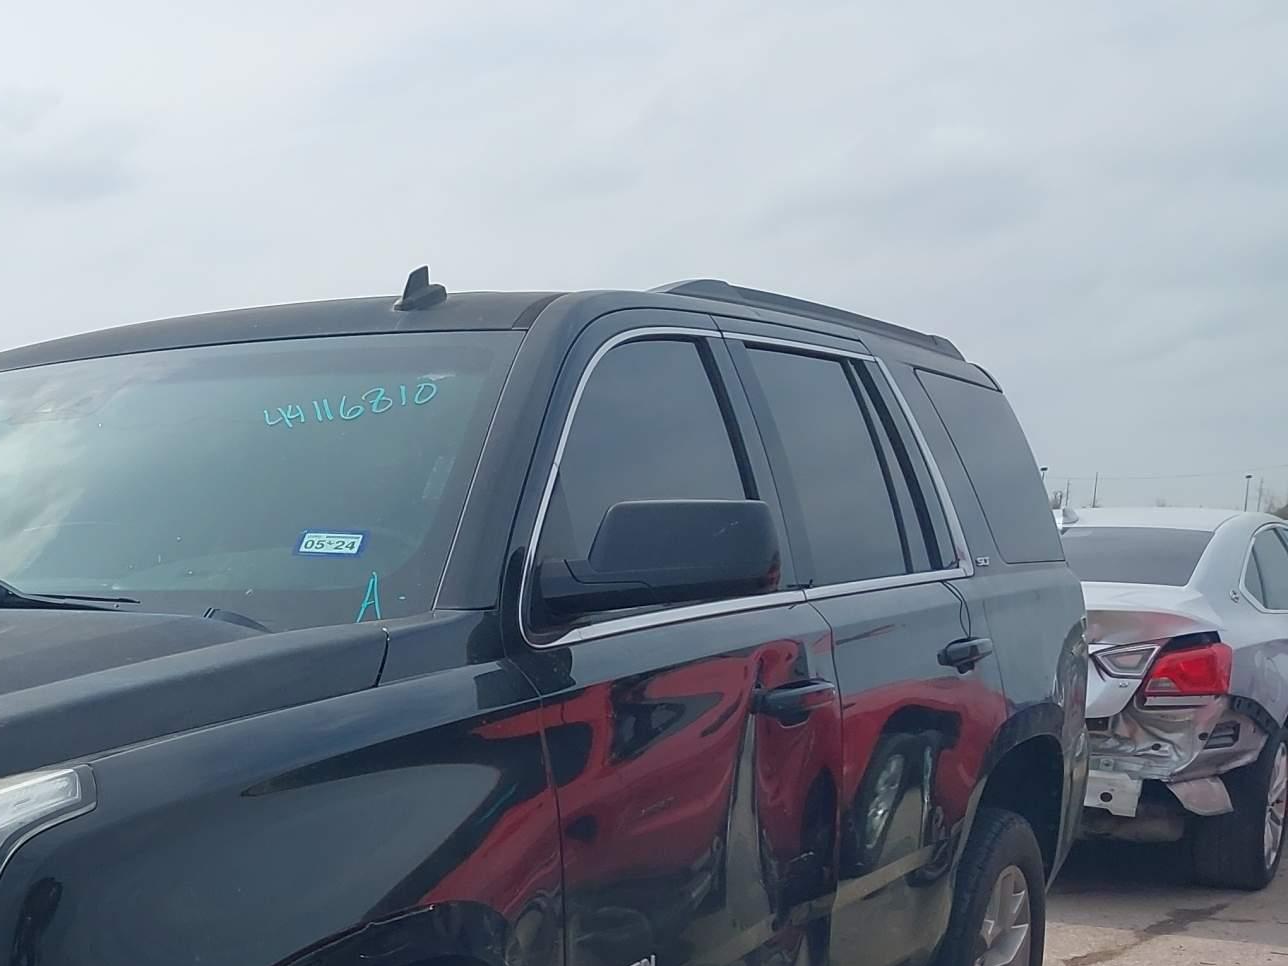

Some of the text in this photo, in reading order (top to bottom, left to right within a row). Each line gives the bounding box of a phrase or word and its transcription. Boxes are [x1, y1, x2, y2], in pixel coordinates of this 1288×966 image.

[263, 383, 438, 427] 44116810
[304, 539, 356, 551] 05 24
[356, 571, 382, 623] A
